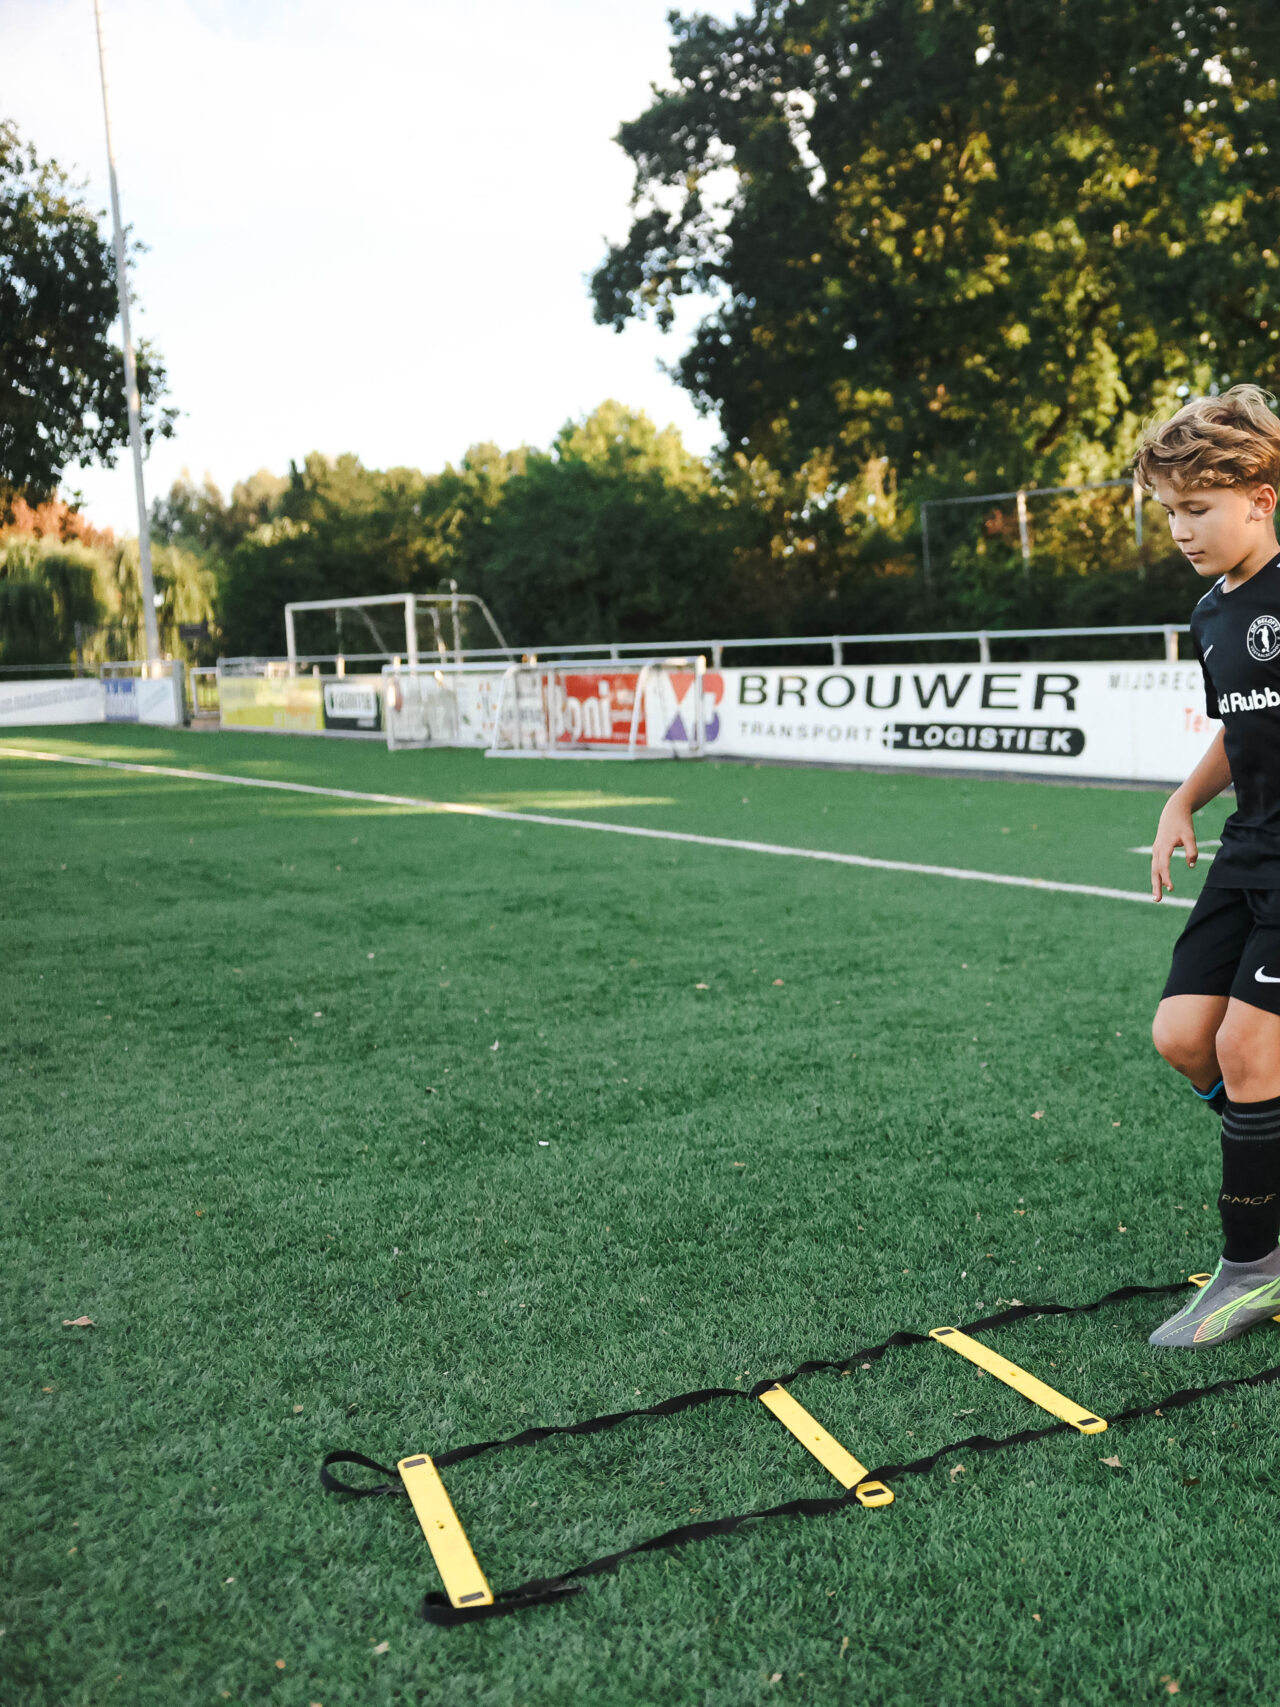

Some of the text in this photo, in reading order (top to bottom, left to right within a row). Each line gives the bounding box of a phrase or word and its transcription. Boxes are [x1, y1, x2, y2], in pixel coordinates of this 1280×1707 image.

[738, 673, 1080, 711] BROUWER
[1108, 671, 1200, 691] MIJDREC
[739, 720, 873, 742] TRANSPORT
[907, 725, 1073, 752] LOGISTIEK
